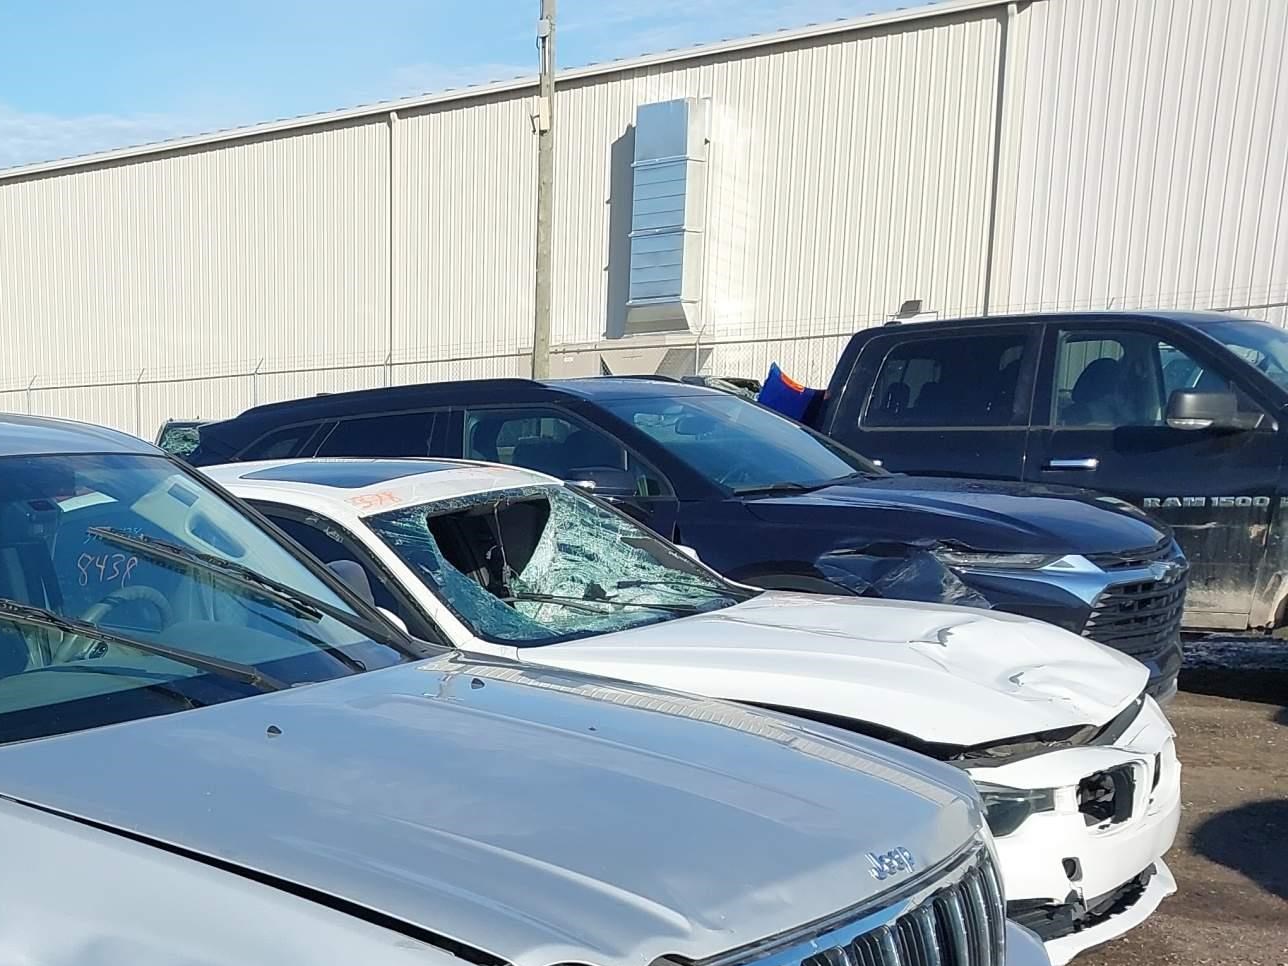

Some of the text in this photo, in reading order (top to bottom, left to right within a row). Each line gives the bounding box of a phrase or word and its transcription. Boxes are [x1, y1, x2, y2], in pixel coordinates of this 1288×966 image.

[1143, 497, 1206, 508] RAM
[1211, 496, 1270, 508] 1500
[864, 847, 915, 880] Jeep
